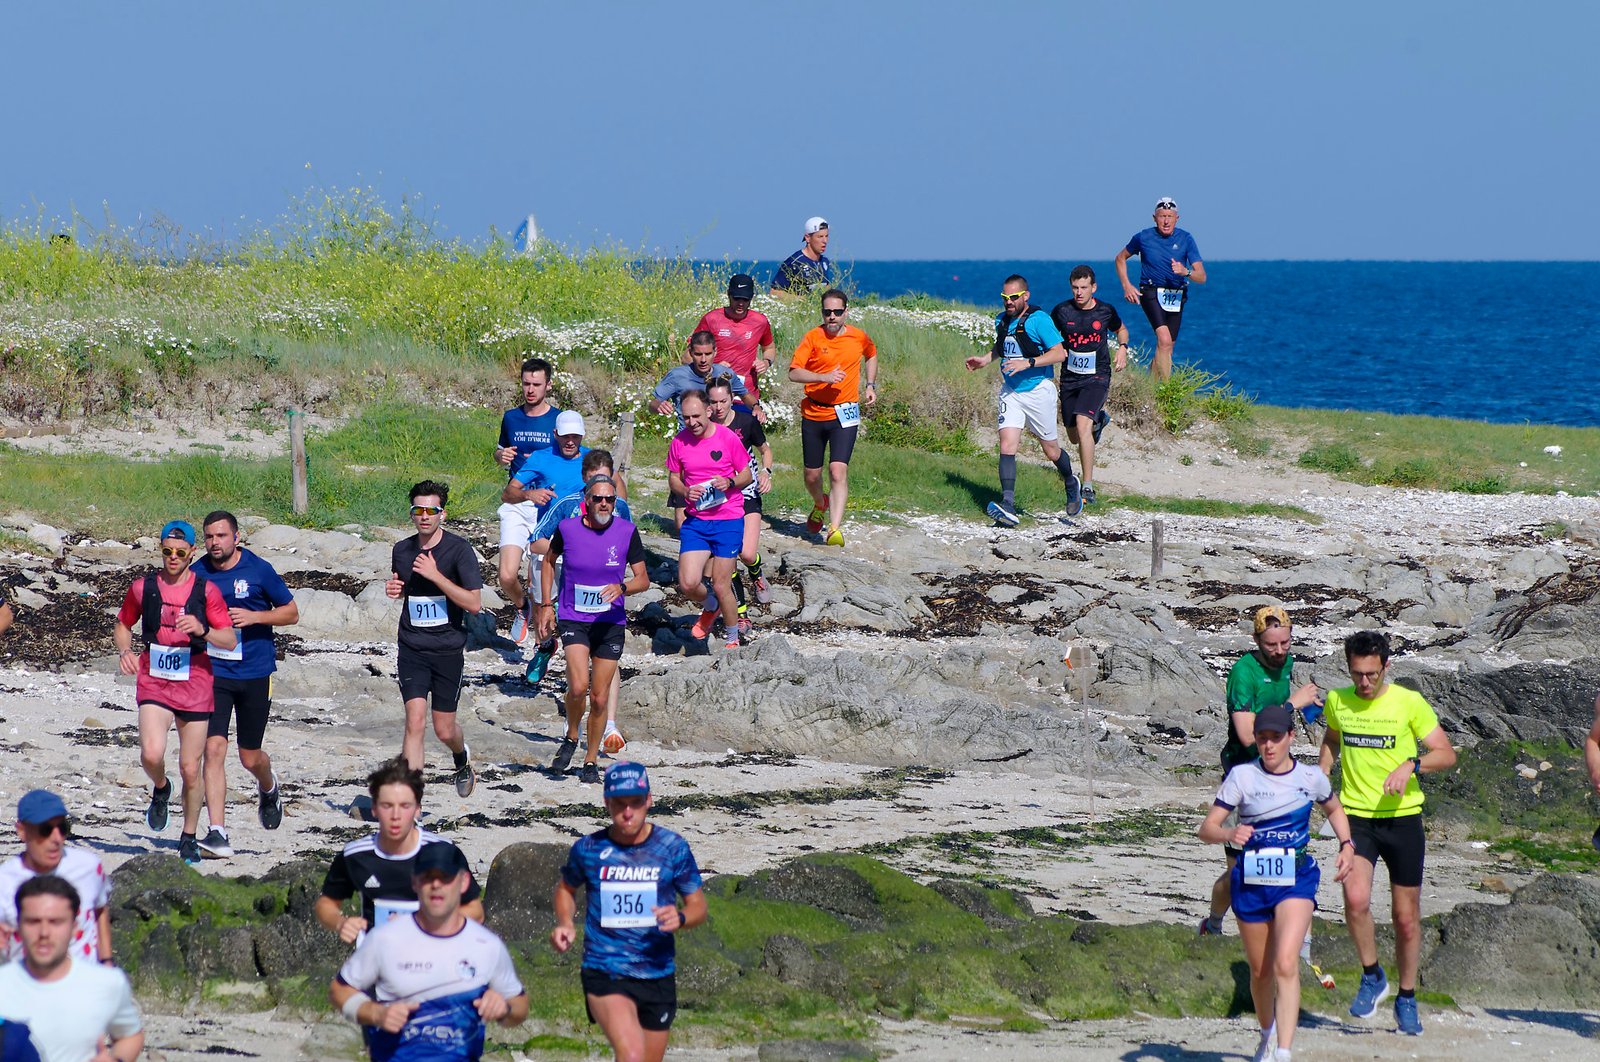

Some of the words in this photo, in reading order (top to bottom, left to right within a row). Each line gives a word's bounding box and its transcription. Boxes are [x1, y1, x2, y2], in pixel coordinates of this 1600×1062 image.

[1072, 357, 1090, 369] 432
[843, 406, 858, 420] 553
[582, 591, 603, 605] 778
[416, 603, 437, 618] 911
[158, 653, 181, 671] 608
[606, 865, 661, 881] FRANCE
[1256, 857, 1284, 877] 518
[613, 894, 644, 915] 356
